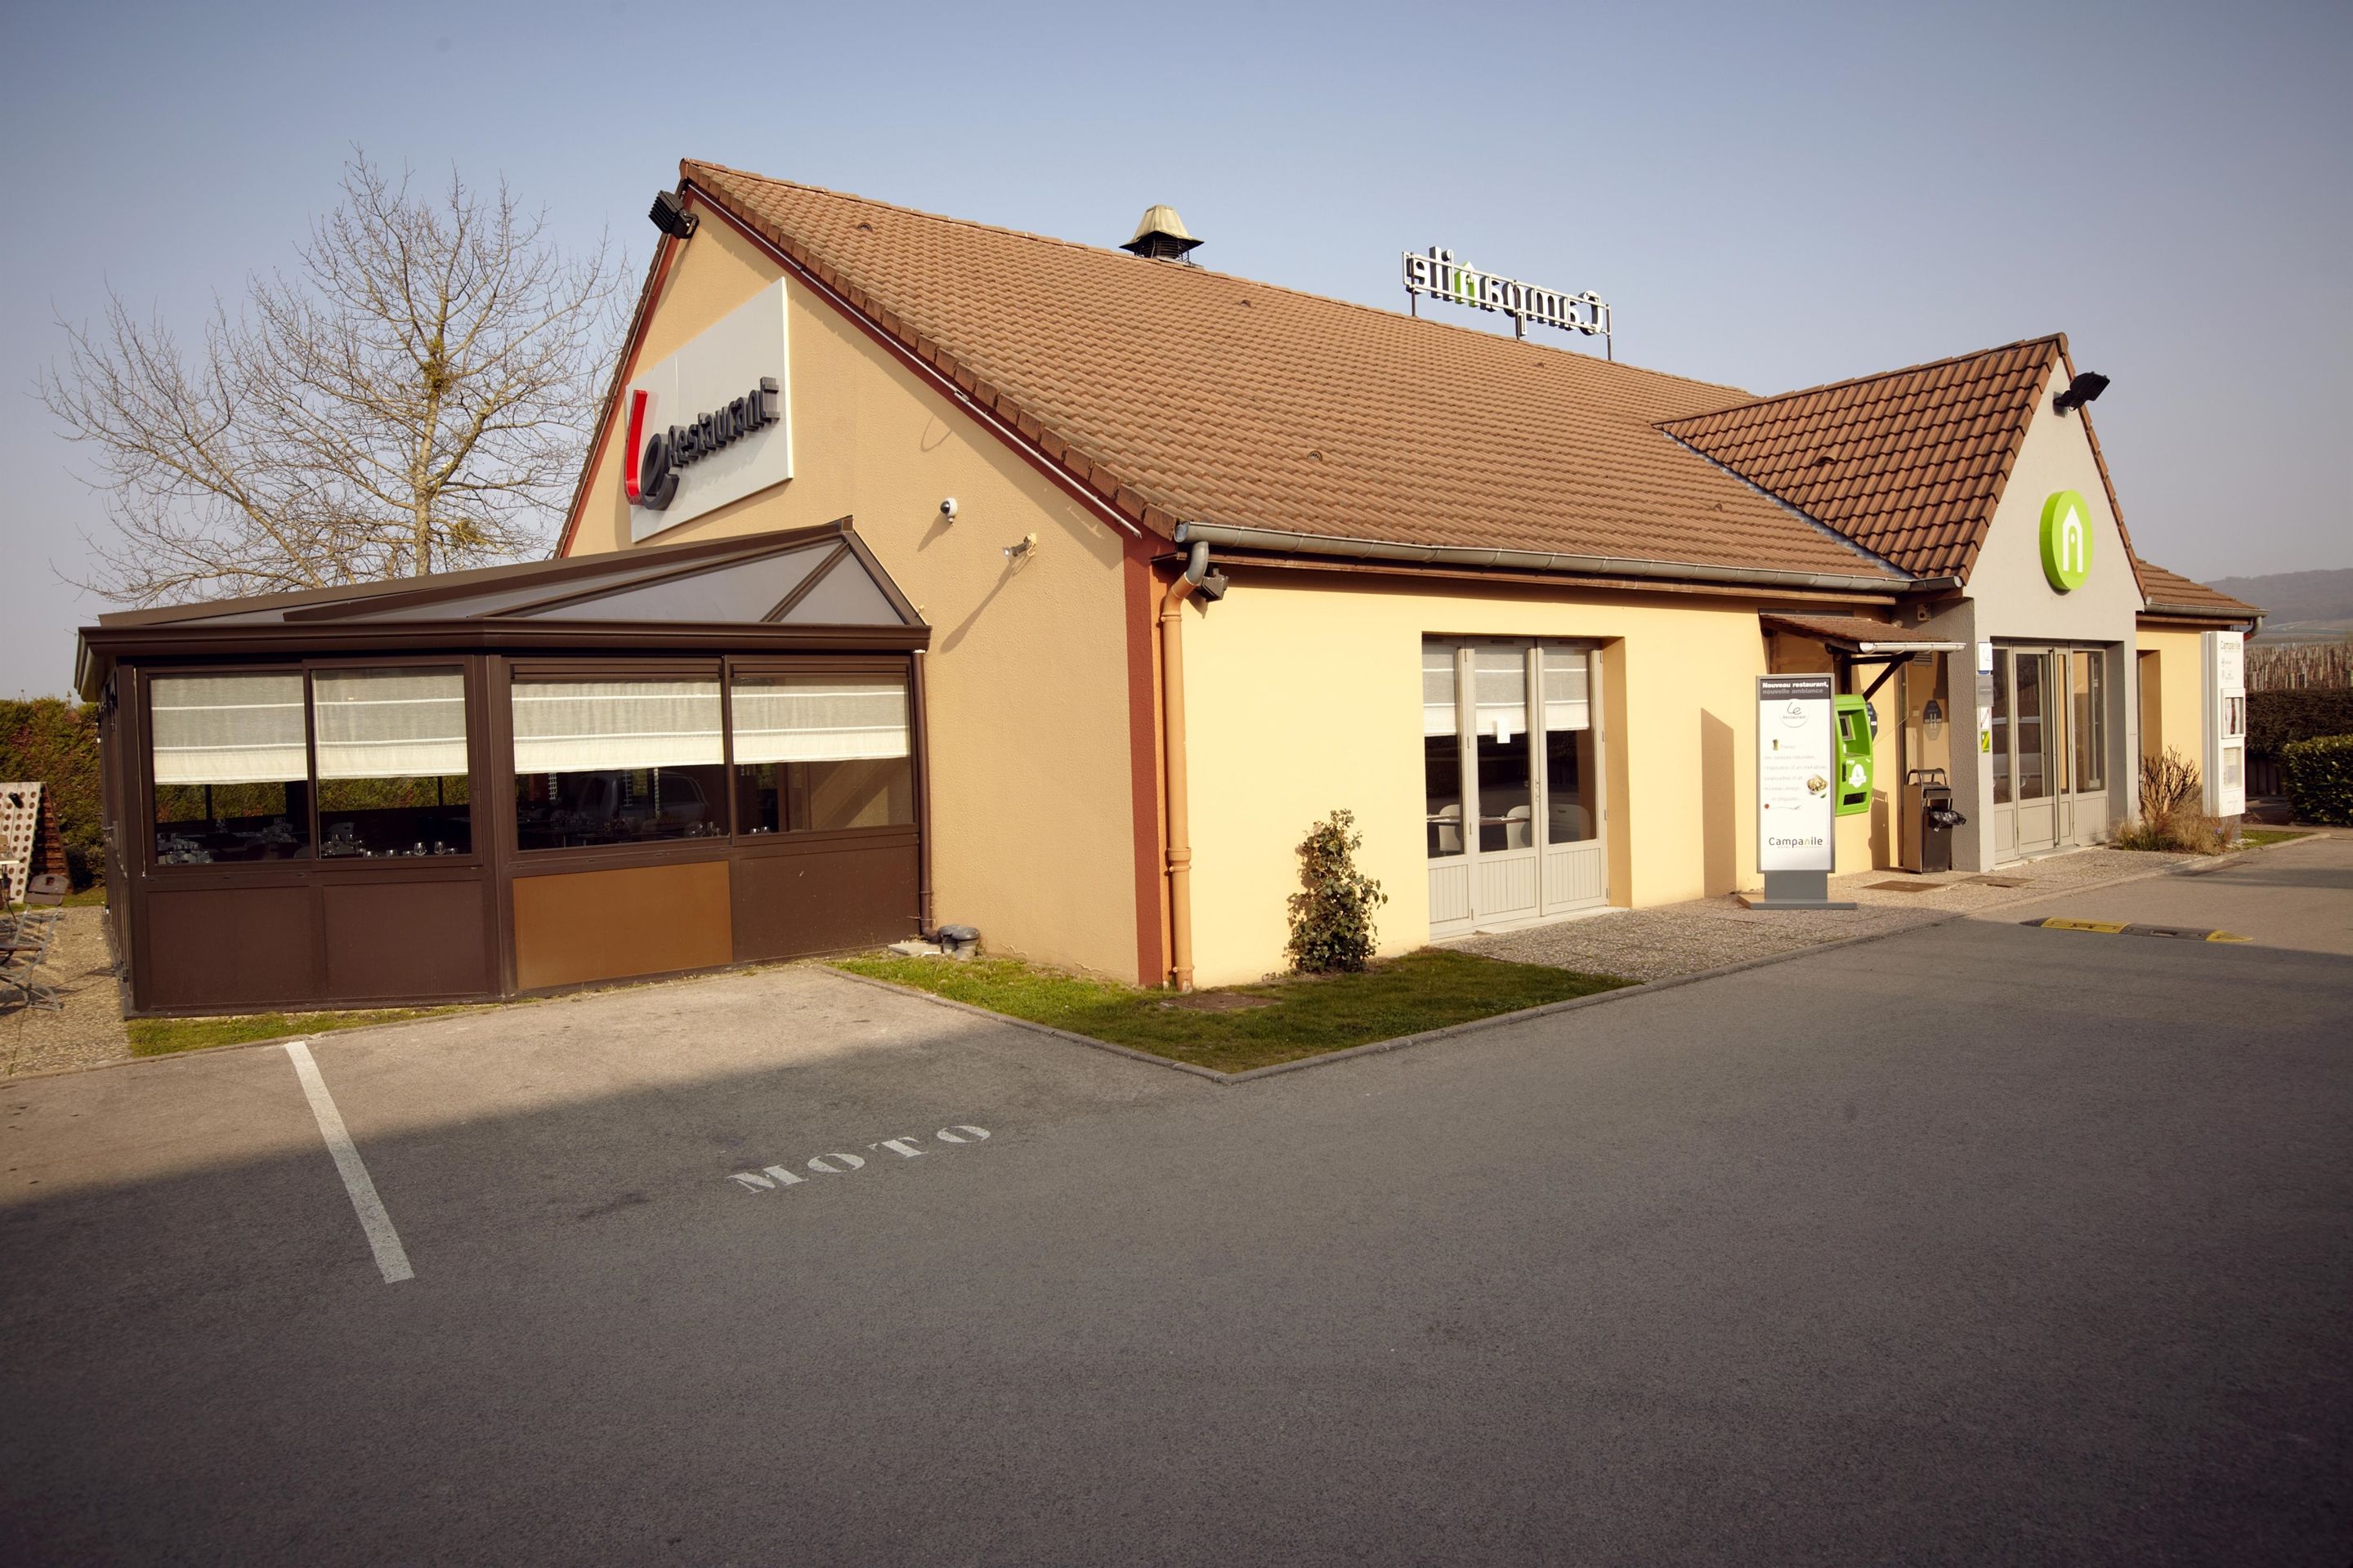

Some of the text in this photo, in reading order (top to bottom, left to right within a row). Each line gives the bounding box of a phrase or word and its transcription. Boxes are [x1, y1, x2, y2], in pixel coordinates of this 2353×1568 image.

[668, 377, 780, 468] Restaurant
[1787, 701, 1802, 715] Le
[1769, 836, 1823, 849] Campanile
[727, 1125, 991, 1194] MOTO
